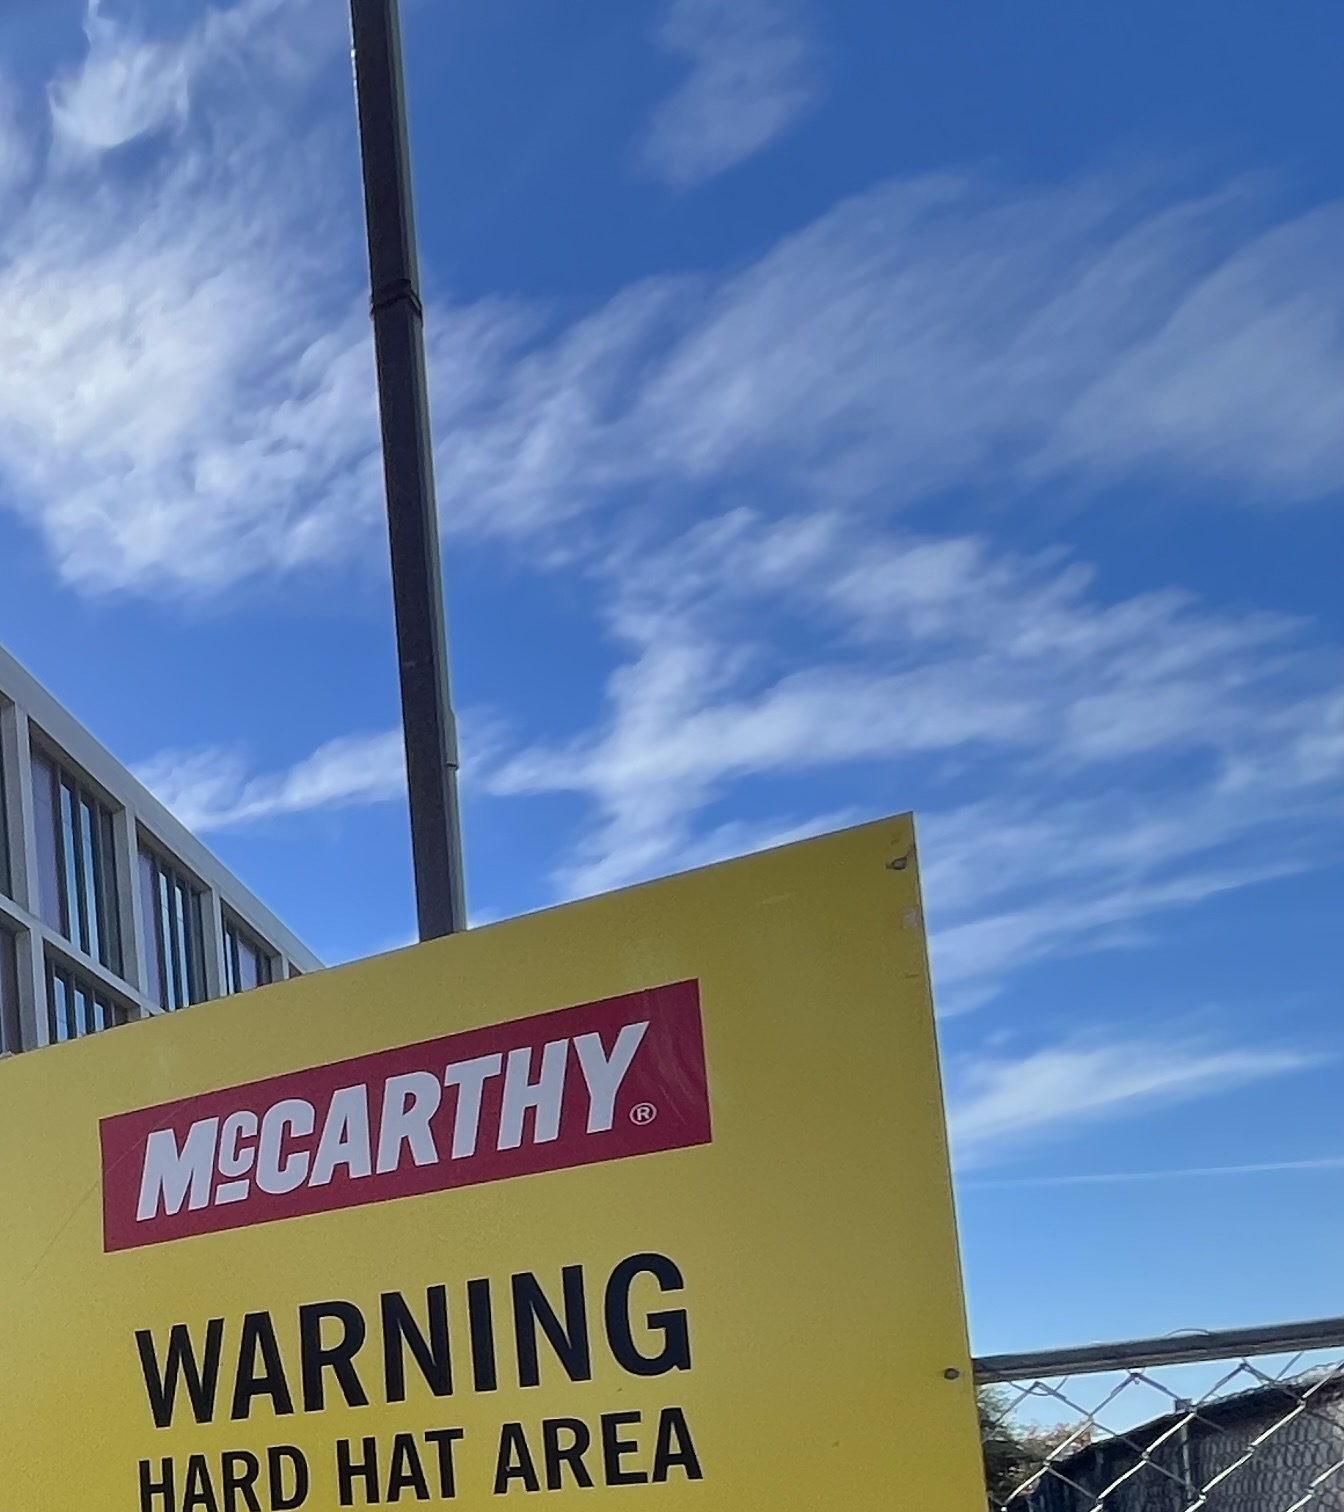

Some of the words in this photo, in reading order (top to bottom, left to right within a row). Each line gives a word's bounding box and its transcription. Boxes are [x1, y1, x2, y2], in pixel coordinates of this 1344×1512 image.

[135, 1251, 692, 1430] WARNING
[336, 1428, 464, 1507] HAT
[493, 1406, 704, 1495] AREA
